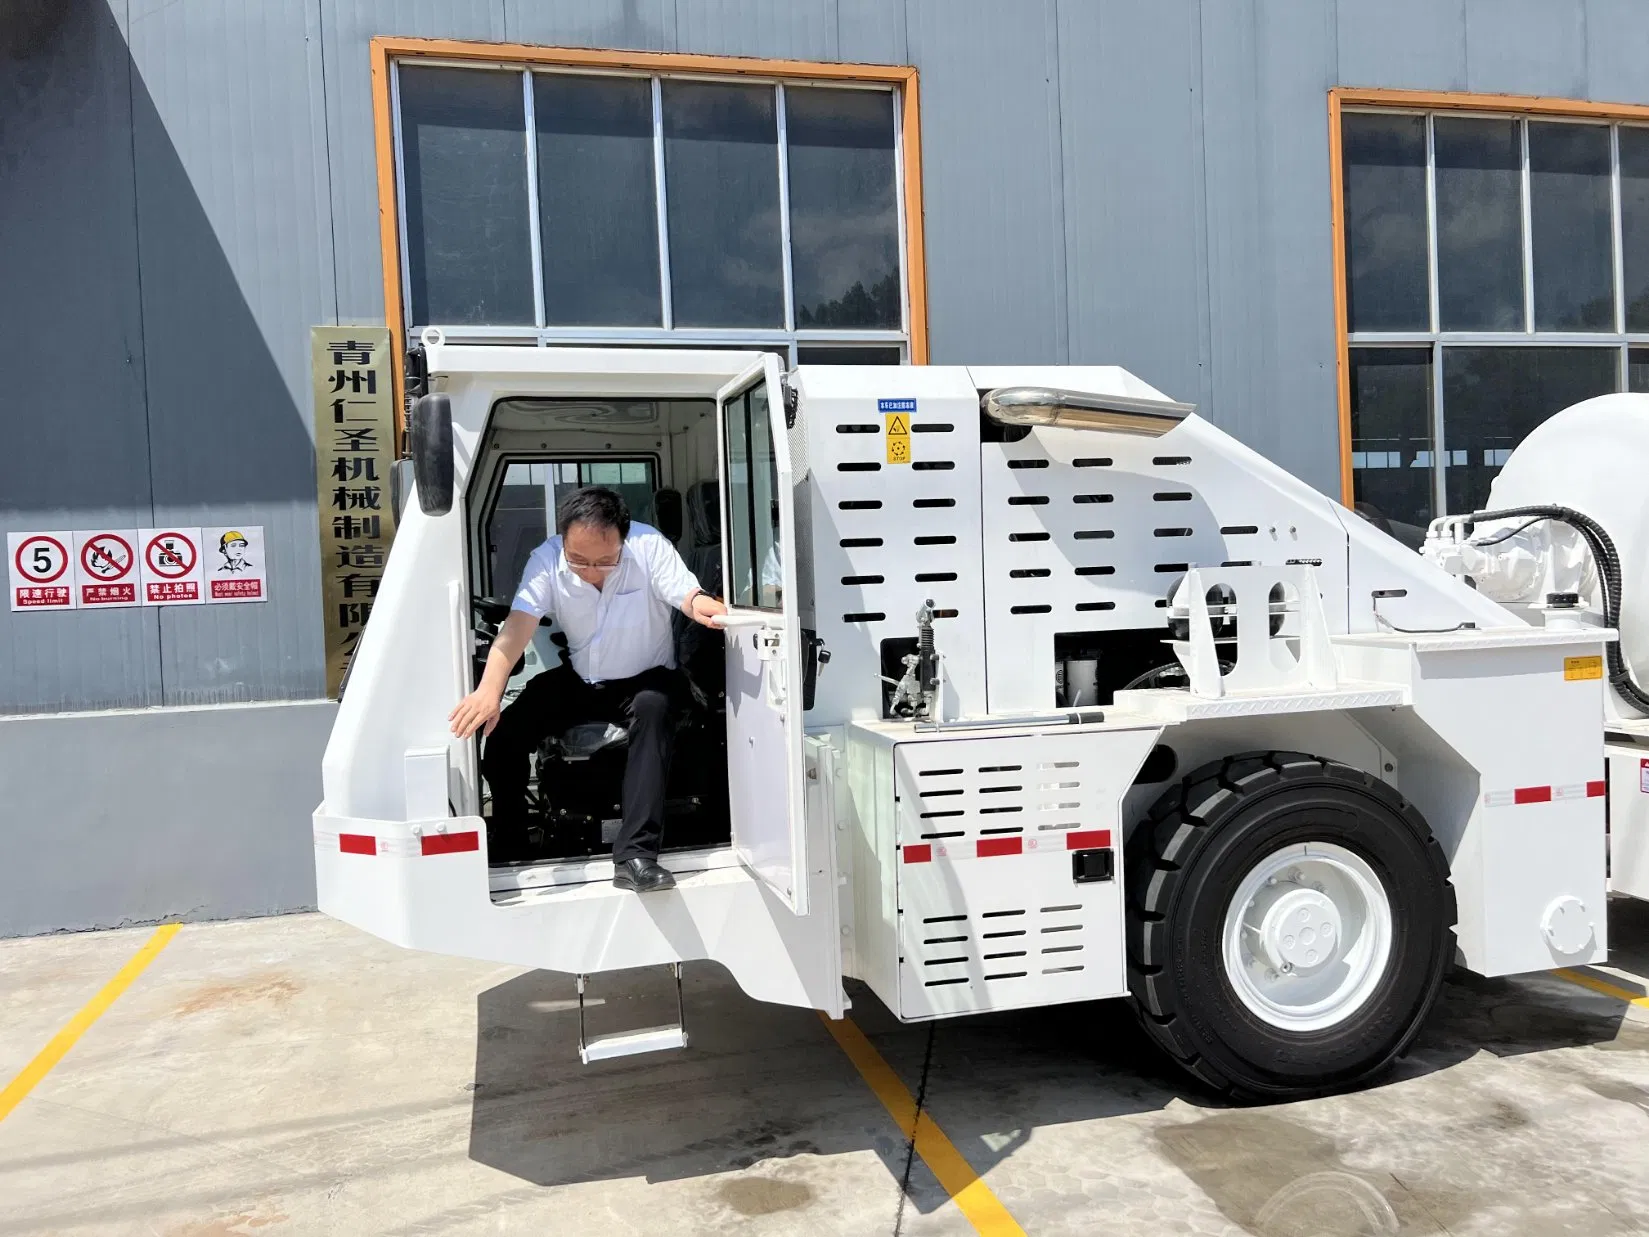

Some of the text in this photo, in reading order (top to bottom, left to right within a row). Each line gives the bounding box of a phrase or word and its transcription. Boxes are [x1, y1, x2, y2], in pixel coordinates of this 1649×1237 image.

[326, 340, 383, 673] 青州仁圣机械制造有限
[33, 548, 52, 573] 5
[86, 587, 131, 596] 严禁烟火
[150, 583, 195, 594] 禁止拍照
[215, 582, 258, 591] 必须戴安全帽
[19, 588, 67, 599] 限速行驶
